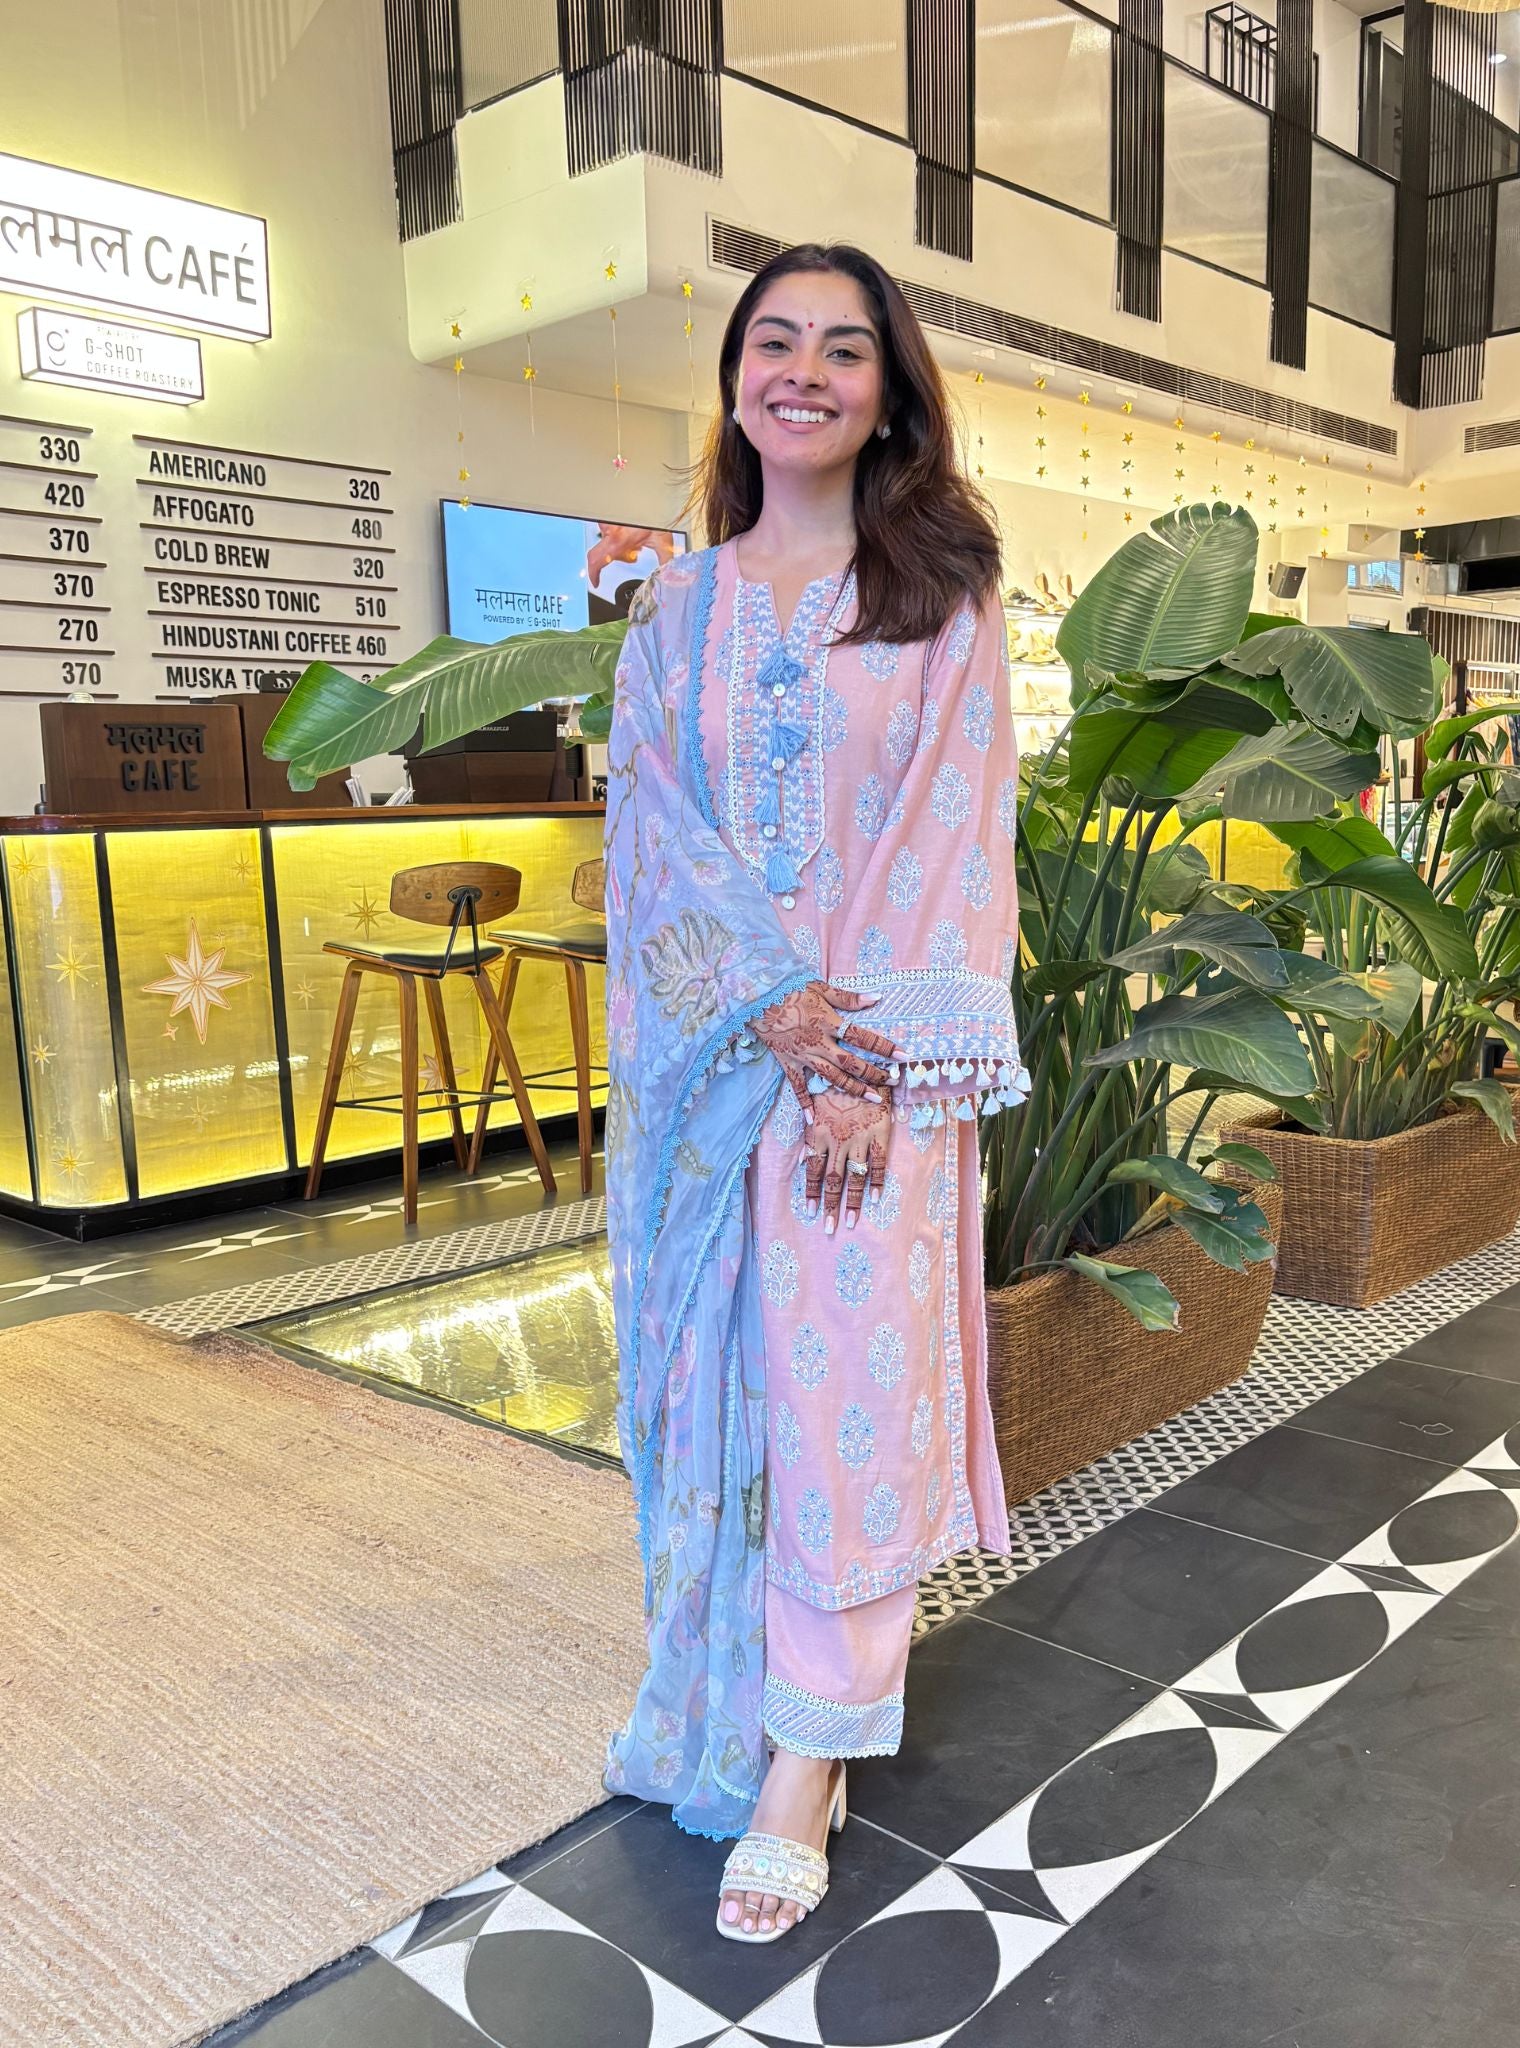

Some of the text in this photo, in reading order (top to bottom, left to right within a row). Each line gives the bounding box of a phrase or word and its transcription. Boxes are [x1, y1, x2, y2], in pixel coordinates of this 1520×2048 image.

[144, 234, 257, 306] CAFÉ
[85, 338, 144, 365] G-SHOT
[86, 360, 194, 390] COFFEE ROASTERY
[40, 436, 80, 463] 330
[149, 450, 380, 501] AMERICANO 320
[44, 482, 85, 508] 420
[153, 494, 383, 541] AFFOGATO 480
[49, 527, 90, 554] 370
[154, 537, 384, 580] COLD BREW 320
[53, 572, 94, 598] 370
[157, 581, 386, 618] ESPRESSO TONIC 510
[474, 588, 564, 615] मलमल CAFE
[58, 618, 99, 642] 270
[483, 614, 561, 629] POWERED BY G-SHOT
[162, 624, 387, 656] HINDUSTANI COFFEE 460
[62, 661, 101, 686] 370
[166, 666, 238, 690] MUSKA
[103, 722, 207, 754] मलमल
[121, 759, 201, 793] CAFE
